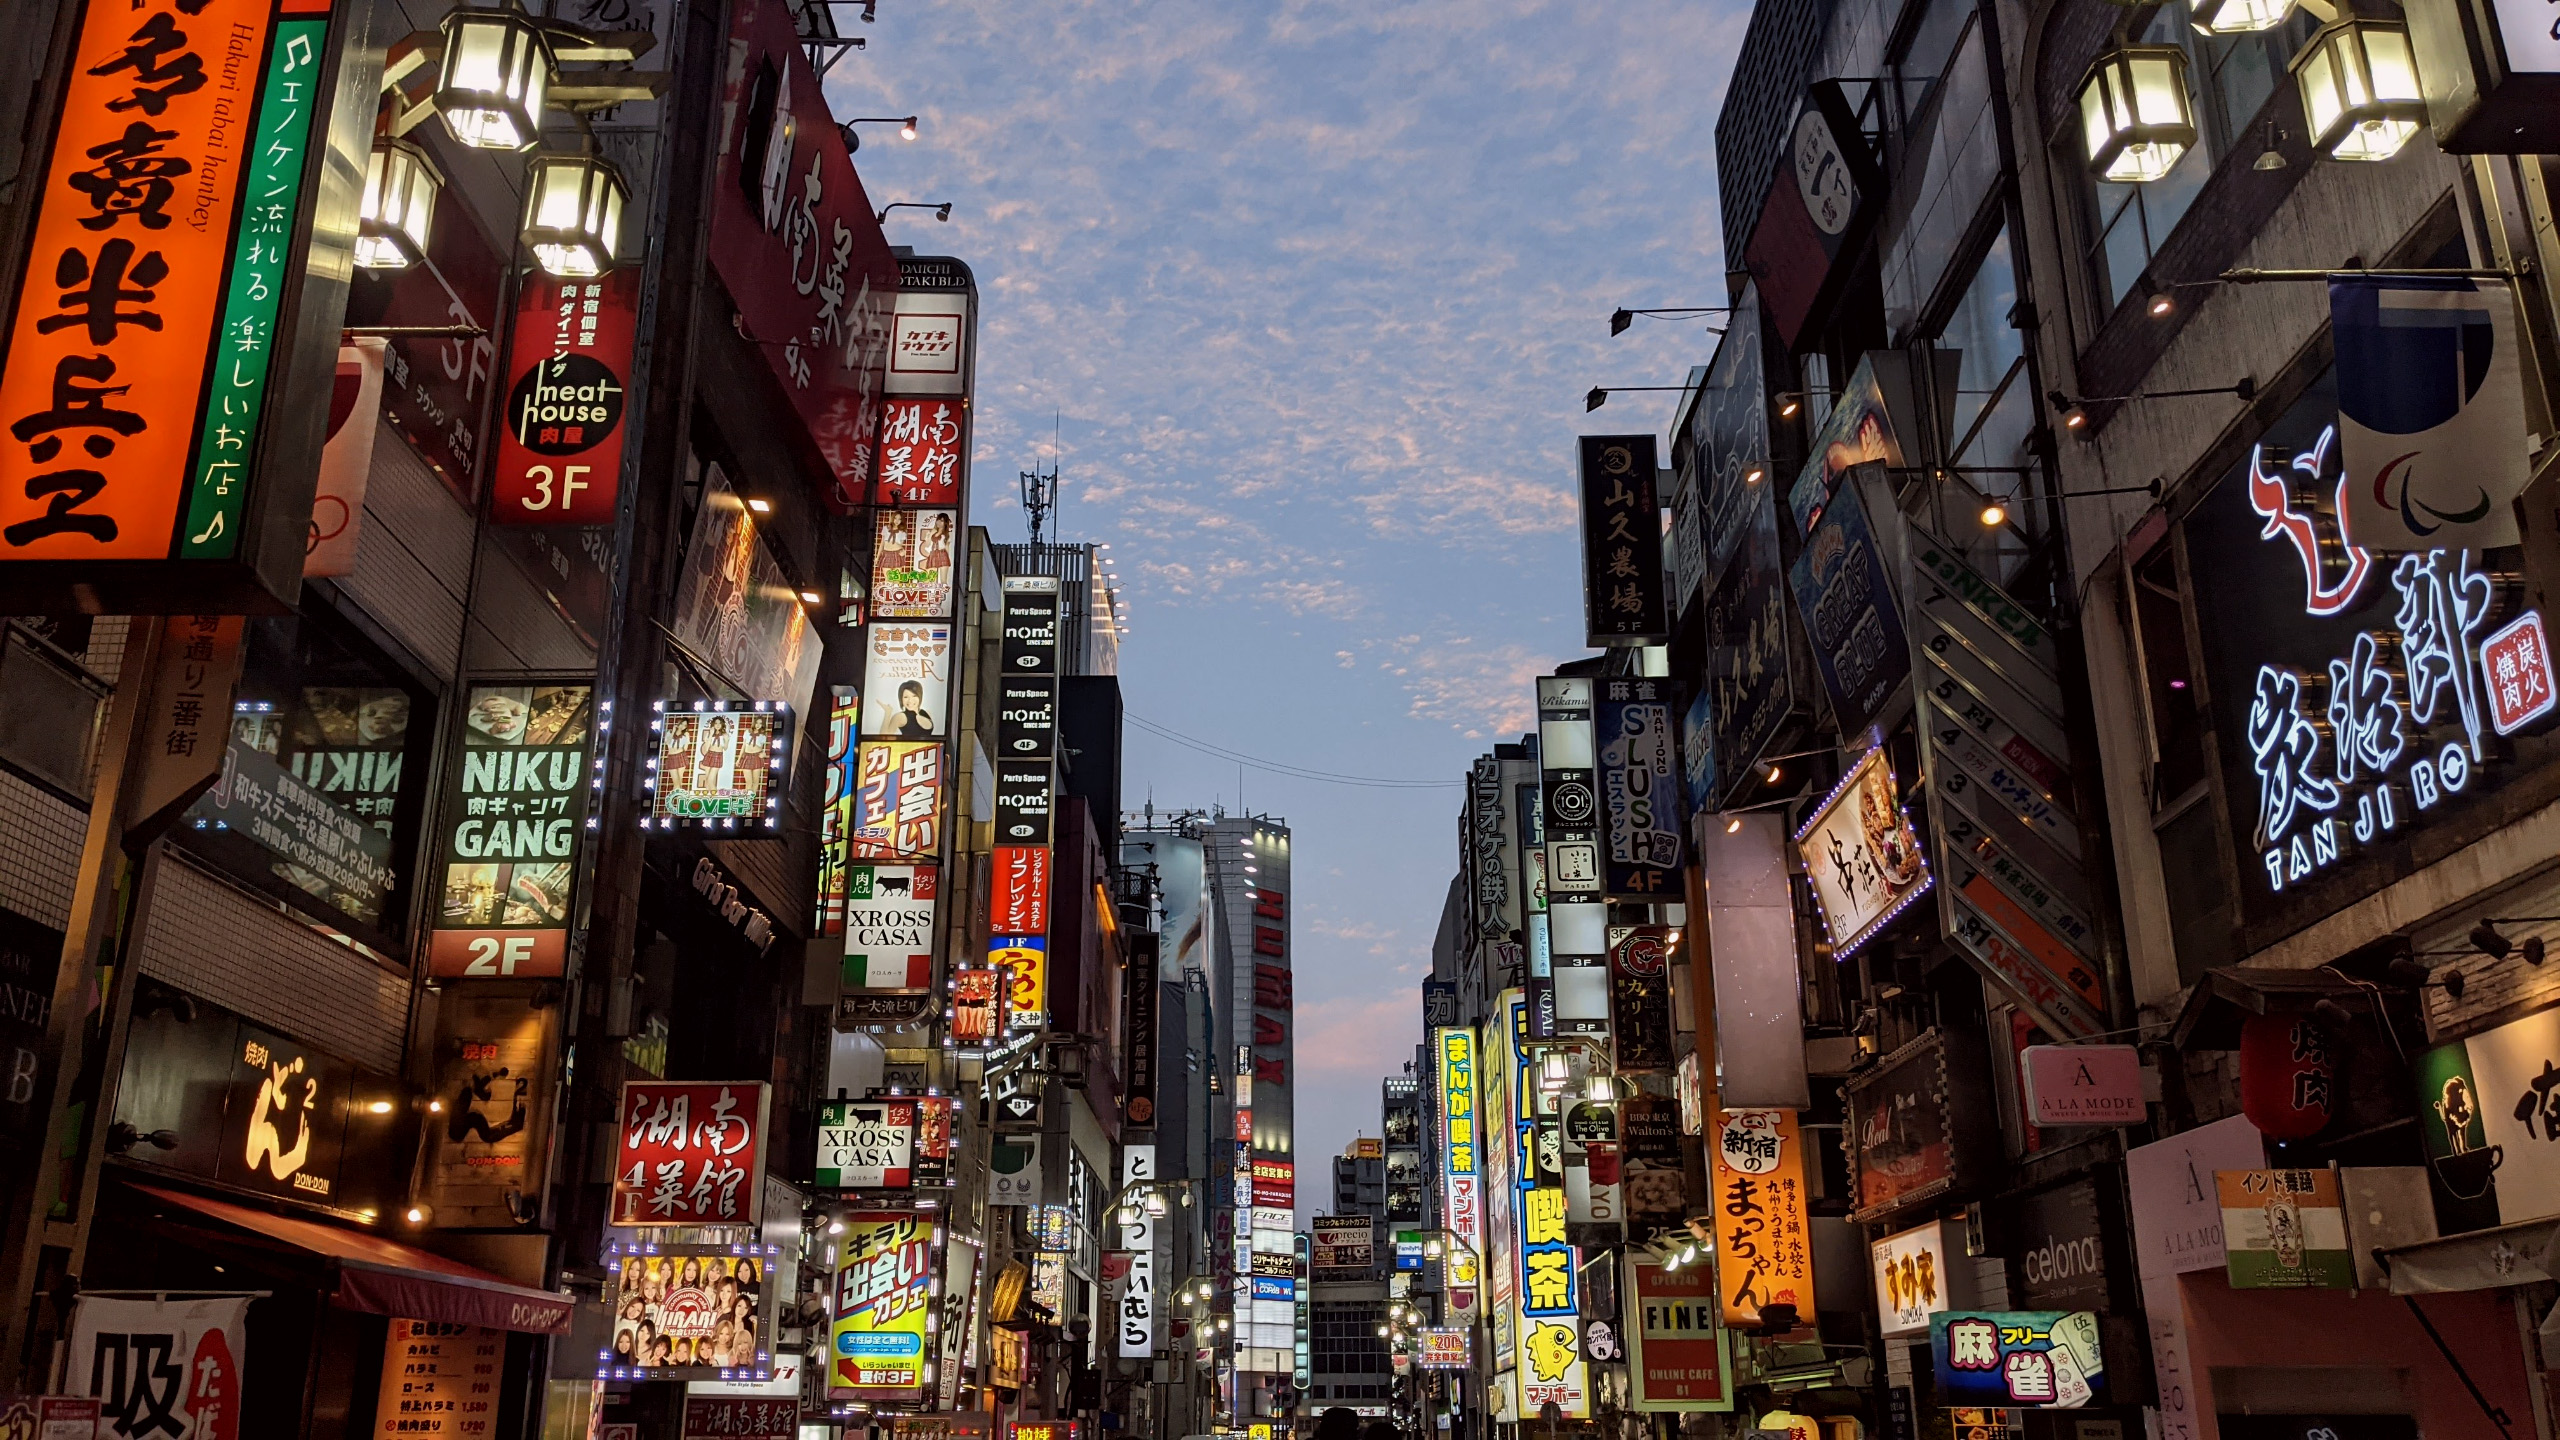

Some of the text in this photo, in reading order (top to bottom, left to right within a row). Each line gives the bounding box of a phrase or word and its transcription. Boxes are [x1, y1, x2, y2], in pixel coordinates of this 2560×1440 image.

[186, 22, 254, 233] Hakuri tabai hanbey
[940, 277, 965, 286] BLD
[578, 284, 601, 346] 新宿個室
[907, 331, 948, 340] カブキ
[900, 341, 953, 351] ラウンジ
[535, 359, 623, 407] meat
[519, 393, 607, 445] house
[882, 403, 960, 445] 湖南
[539, 427, 583, 444] 肉屋
[881, 446, 958, 487] 菜館
[521, 465, 591, 511] 3F
[904, 487, 932, 502] 4F
[1604, 479, 1644, 614] 山久農場
[1814, 541, 1875, 651] GREAT
[1925, 587, 1946, 604] 7
[1010, 608, 1028, 616] Party
[1616, 621, 1642, 632] 5F
[1931, 634, 1950, 652] 6
[1834, 616, 1887, 698] BLUE
[1007, 690, 1025, 698] Party
[1609, 681, 1656, 700] 麻雀
[1936, 680, 1957, 699] 5
[1941, 729, 1961, 745] 4
[461, 752, 581, 792] NIKU
[865, 747, 888, 823] カフェ
[1947, 773, 1967, 794] 3
[467, 796, 568, 815] 肉ギャング
[898, 748, 937, 856] 出会い
[1991, 768, 2055, 827] センチュリー
[1610, 773, 1628, 859] エスラッシュ
[2265, 741, 2467, 892] TAN JI RO
[454, 819, 572, 857] GANG
[856, 827, 890, 837] キラリ
[1565, 833, 1584, 841] 5F
[1950, 821, 1971, 843] 2
[858, 843, 884, 858] 1F
[1477, 757, 1508, 933] カラオケの鉄人
[856, 872, 869, 886] 肉
[1626, 871, 1663, 892] 4F
[852, 886, 871, 894] バル
[1009, 850, 1026, 932] リフレッシュ
[1030, 850, 1042, 928] レンタルルーム ホステル
[1569, 895, 1588, 903] 4F
[849, 910, 931, 927] XROSS
[1834, 914, 1847, 939] 3F
[858, 929, 922, 946] CASA
[1008, 938, 1027, 947] 1F
[1611, 929, 1627, 939] 3F
[464, 937, 534, 975] 2F
[1573, 959, 1592, 967] 3F
[1014, 1013, 1040, 1024] 天神
[1133, 952, 1150, 1087] 個室ダイニング居酒屋
[1577, 1024, 1596, 1032] 2F
[1627, 979, 1647, 1060] カリーナ
[463, 1044, 497, 1060] 焼肉
[1008, 1032, 1036, 1053] Space
[245, 1040, 268, 1069] 焼肉
[1013, 1101, 1028, 1109] B1
[1447, 1038, 1473, 1172] まんが喫茶
[2059, 1099, 2078, 1109] LA
[2086, 1097, 2136, 1108] MODE
[629, 1086, 751, 1155] 湖南
[822, 1107, 834, 1120] 肉
[1630, 1113, 1670, 1122] BBQ 東京
[1575, 1123, 1610, 1133] The Olive
[1628, 1125, 1673, 1136] Walton's
[823, 1129, 905, 1147] XROSS
[833, 1149, 895, 1167] CASA
[2242, 1171, 2316, 1194] インド舞踊
[1239, 1209, 1247, 1234] SEGA
[1766, 1179, 1787, 1277] 九州のうまかもん
[1782, 1178, 1805, 1279] 博多もつ鍋 水炊き
[848, 1214, 917, 1257] キラリ
[1726, 1177, 1770, 1312] まっちゃん
[842, 1243, 924, 1310] 出会い
[873, 1283, 924, 1326] カフェ
[1646, 1306, 1710, 1330] FINE
[2000, 1326, 2050, 1346] フリー
[408, 1345, 440, 1355] カルビ
[405, 1364, 437, 1374] ハラミ
[859, 1371, 913, 1383] 受付3F
[1650, 1368, 1713, 1381] ONLINE CAFE
[91, 1332, 184, 1440] 吸
[403, 1382, 434, 1392] ロース
[1526, 1386, 1580, 1404] マンボー
[1676, 1384, 1690, 1396] B1
